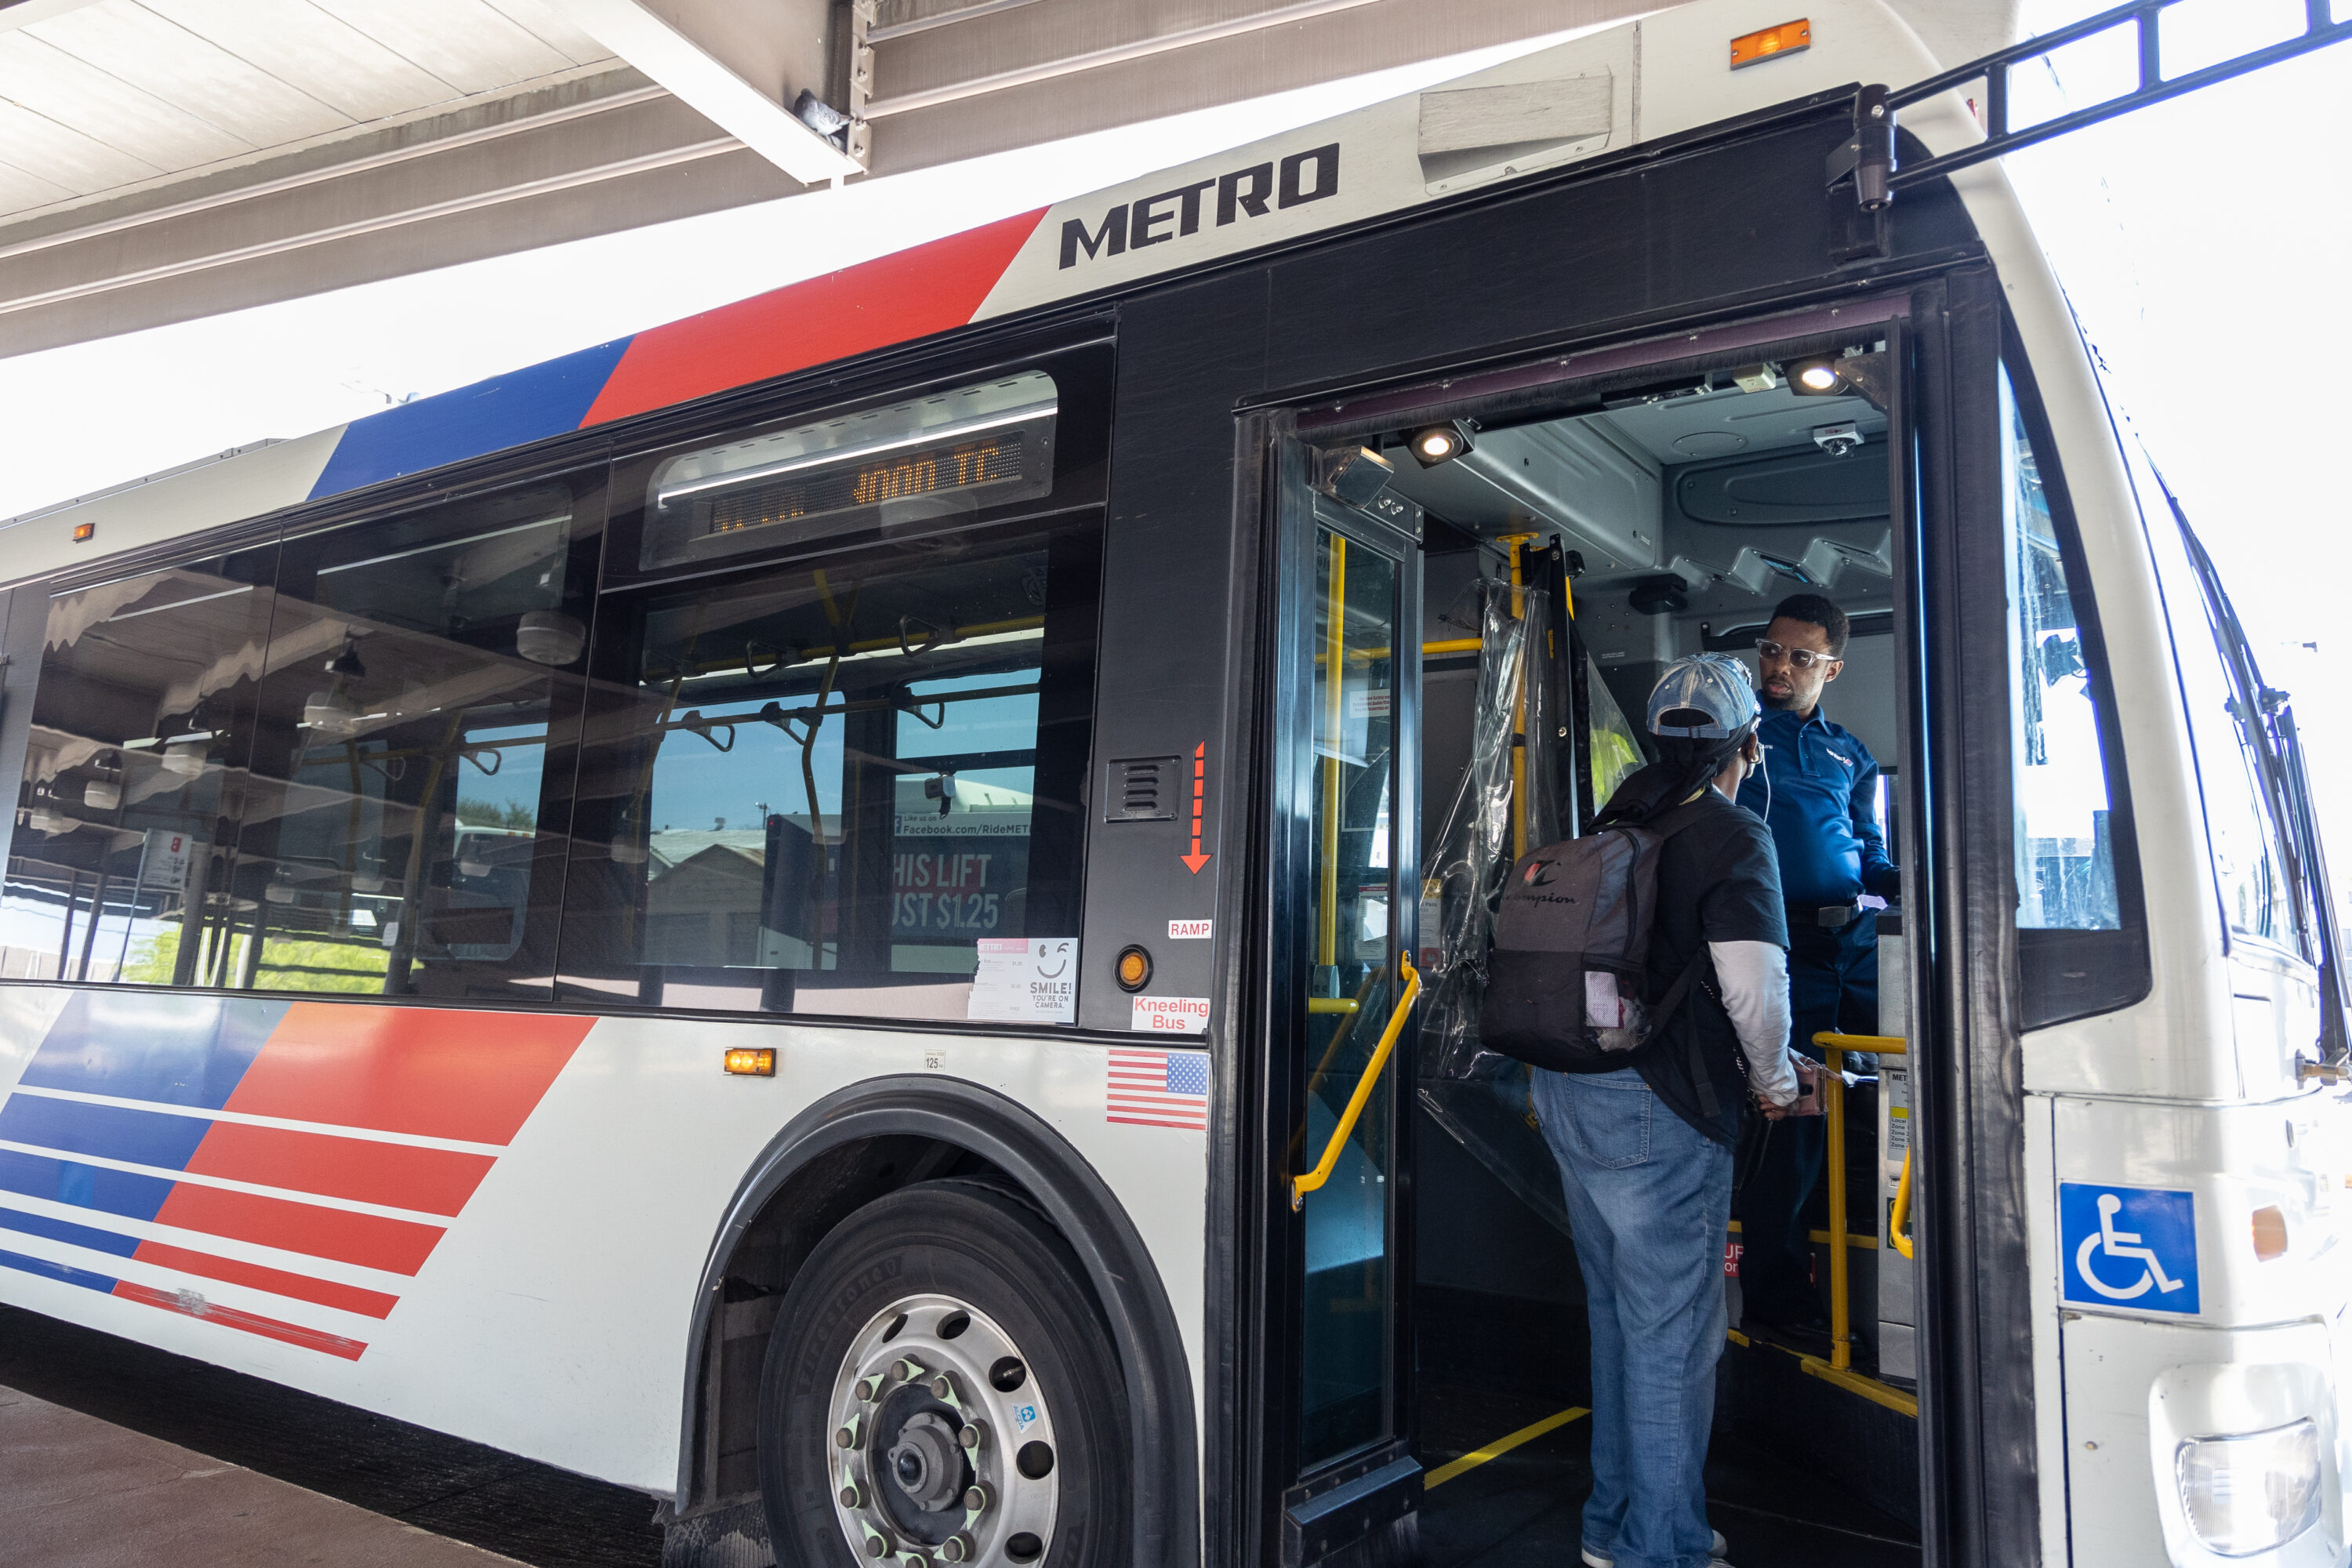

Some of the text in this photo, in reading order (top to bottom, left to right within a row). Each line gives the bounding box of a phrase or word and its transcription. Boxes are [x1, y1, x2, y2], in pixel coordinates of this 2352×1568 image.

[1059, 142, 1340, 270] METRO
[903, 825, 1031, 835] Facebook.com/RideMET
[936, 854, 992, 887] LIFT
[1503, 893, 1576, 908] ampion
[936, 892, 999, 929] $1.25
[1171, 923, 1210, 936] RAMP
[1029, 982, 1072, 994] SMILE!
[1134, 997, 1209, 1017] Kneeling
[1152, 1014, 1186, 1029] Bus
[926, 1057, 938, 1069] 125
[1892, 1073, 1907, 1082] MET
